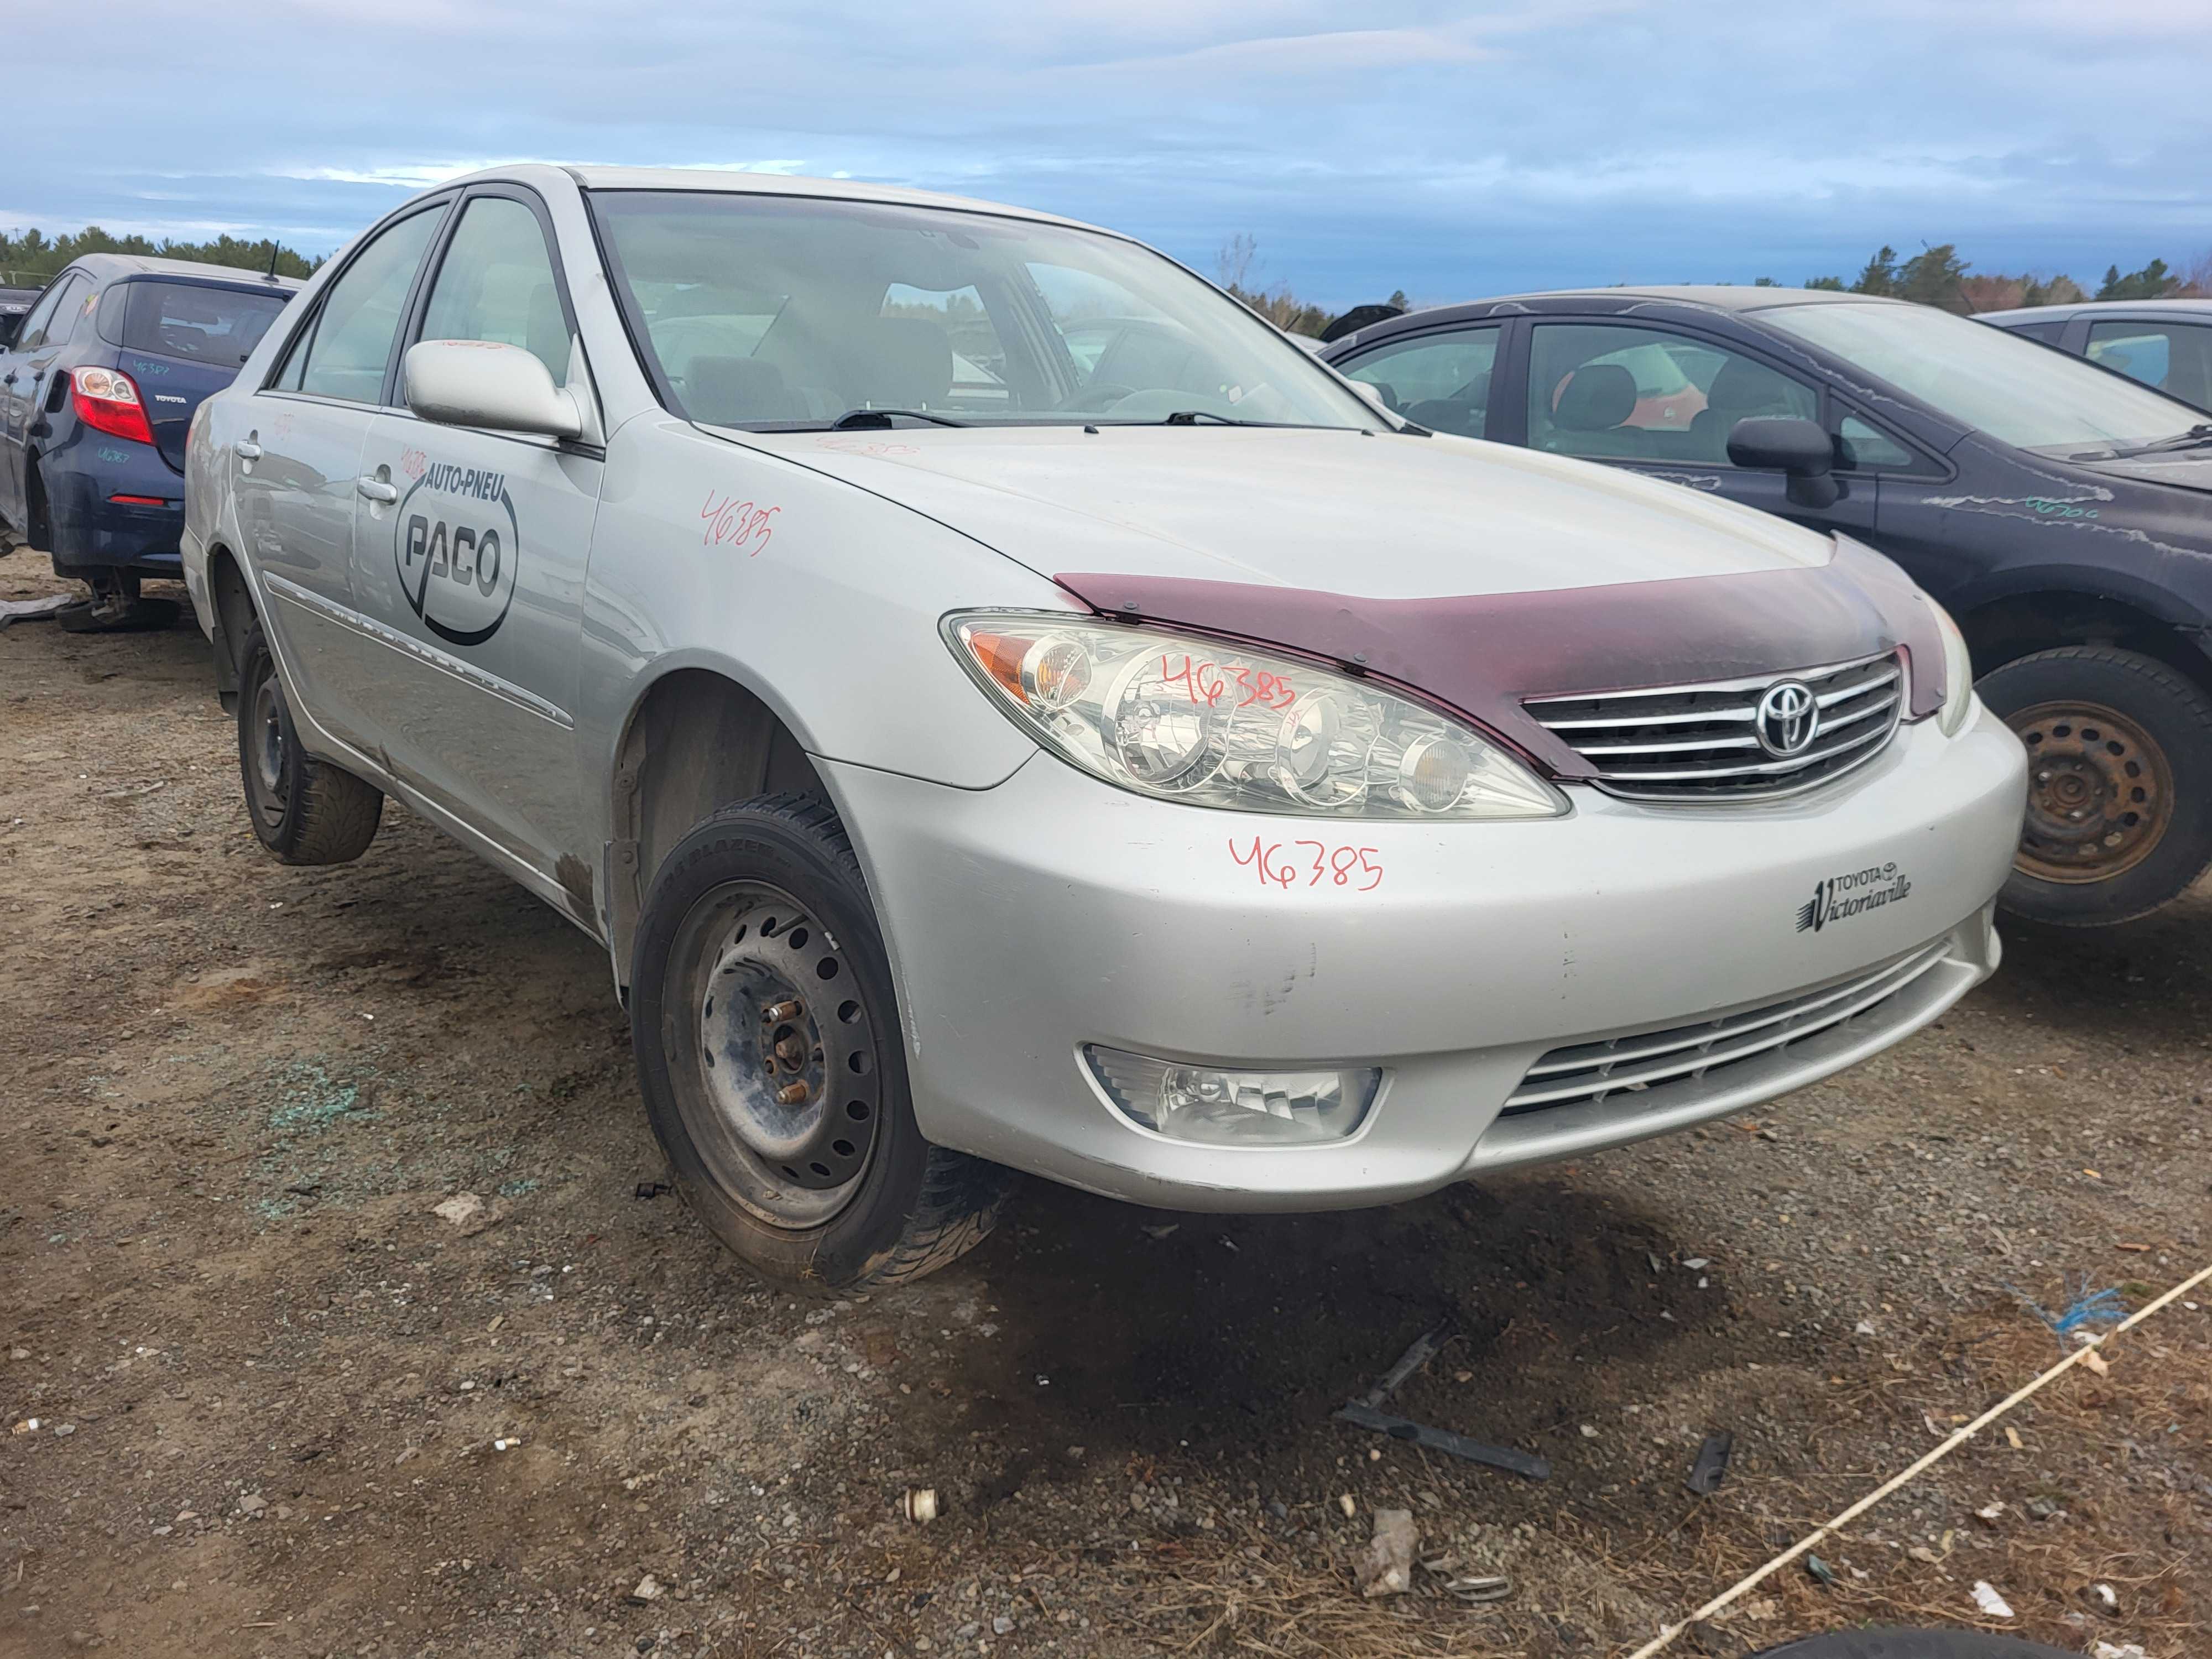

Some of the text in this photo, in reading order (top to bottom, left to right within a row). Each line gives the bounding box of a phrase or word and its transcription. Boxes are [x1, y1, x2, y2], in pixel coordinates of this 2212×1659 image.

[155, 395, 187, 404] TOYOTA
[425, 462, 504, 502] AUTO-PNEU
[702, 489, 781, 557] 46385
[405, 514, 501, 598] PACO
[1162, 655, 1295, 709] 46385
[1229, 836, 1383, 891] 46385
[1835, 867, 1881, 892] TOYOTA
[1814, 874, 1912, 932] Victoriaville
